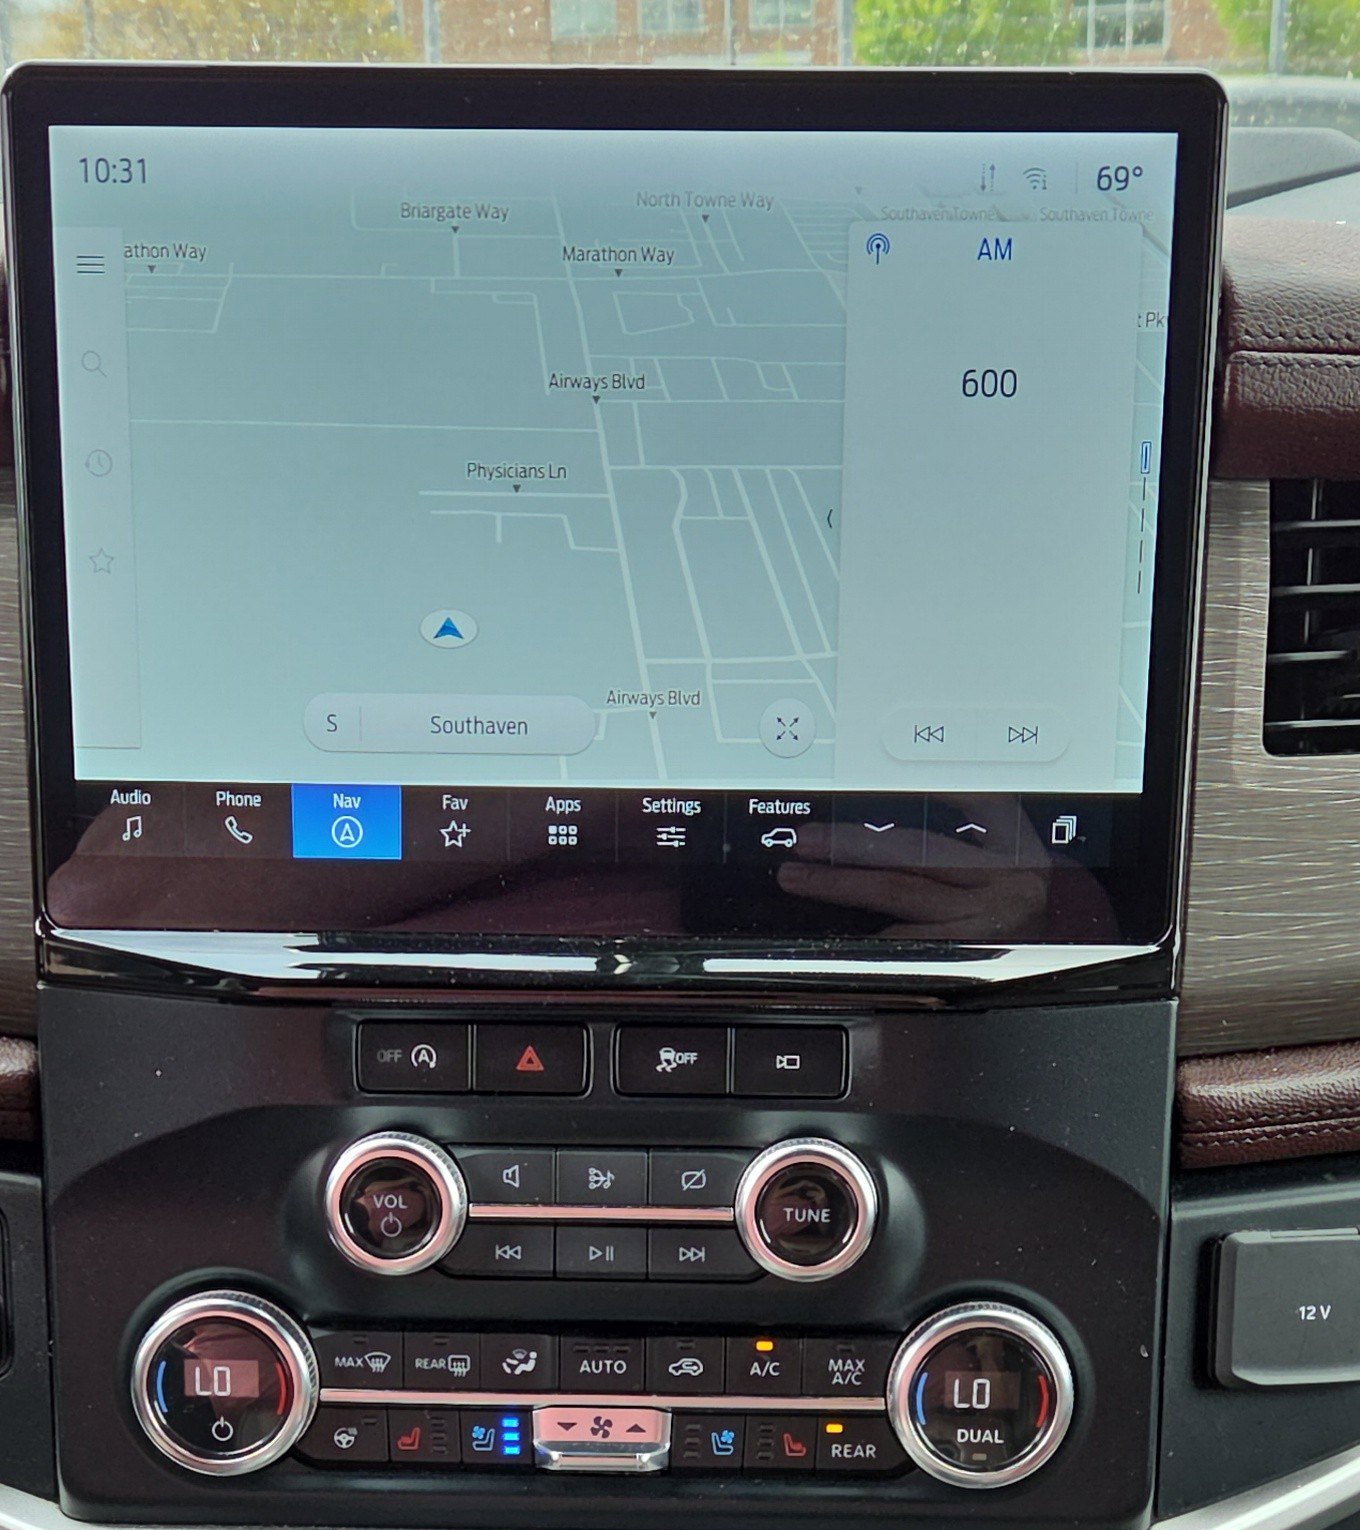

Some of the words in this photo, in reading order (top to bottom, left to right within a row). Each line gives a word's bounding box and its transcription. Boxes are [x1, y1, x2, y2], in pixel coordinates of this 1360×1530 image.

[77, 157, 149, 185] 10:31
[1096, 165, 1144, 192] 69°
[636, 191, 682, 208] North
[684, 191, 737, 209] Towne
[740, 192, 775, 211] Way
[399, 202, 472, 222] Briargate
[474, 203, 509, 222] Way
[124, 242, 170, 259] athon
[173, 242, 207, 262] Way
[562, 245, 638, 263] Marathon
[640, 246, 675, 266] Way
[977, 237, 1013, 261] AM
[548, 373, 609, 392] Airways
[612, 373, 646, 391] Blvd
[961, 368, 1018, 399] 600
[466, 462, 546, 481] Physicians
[548, 462, 567, 480] Ln
[606, 689, 664, 708] Airways
[668, 689, 702, 706] Blvd
[326, 713, 338, 733] S
[429, 714, 529, 736] Southaven
[110, 789, 152, 807] Audio
[215, 790, 262, 808] Phone
[332, 793, 362, 809] Nav
[441, 794, 470, 811] Fav
[545, 796, 582, 815] Apps
[641, 797, 702, 815] Settings
[748, 799, 811, 816] Features
[376, 1048, 403, 1063] OFF
[675, 1051, 698, 1064] OFF
[372, 1194, 408, 1210] VOL
[782, 1207, 832, 1224] TUNE
[1298, 1305, 1316, 1321] 12
[1319, 1304, 1332, 1320] V
[334, 1356, 364, 1368] MAX
[414, 1357, 446, 1370] REAR
[579, 1360, 627, 1375] AUTO
[749, 1361, 781, 1378] A/C
[827, 1359, 866, 1373] MAX
[193, 1365, 233, 1397] LO
[831, 1371, 862, 1386] A/C
[952, 1378, 992, 1409] LO
[956, 1428, 1005, 1445] DUAL
[830, 1443, 877, 1459] REAR
